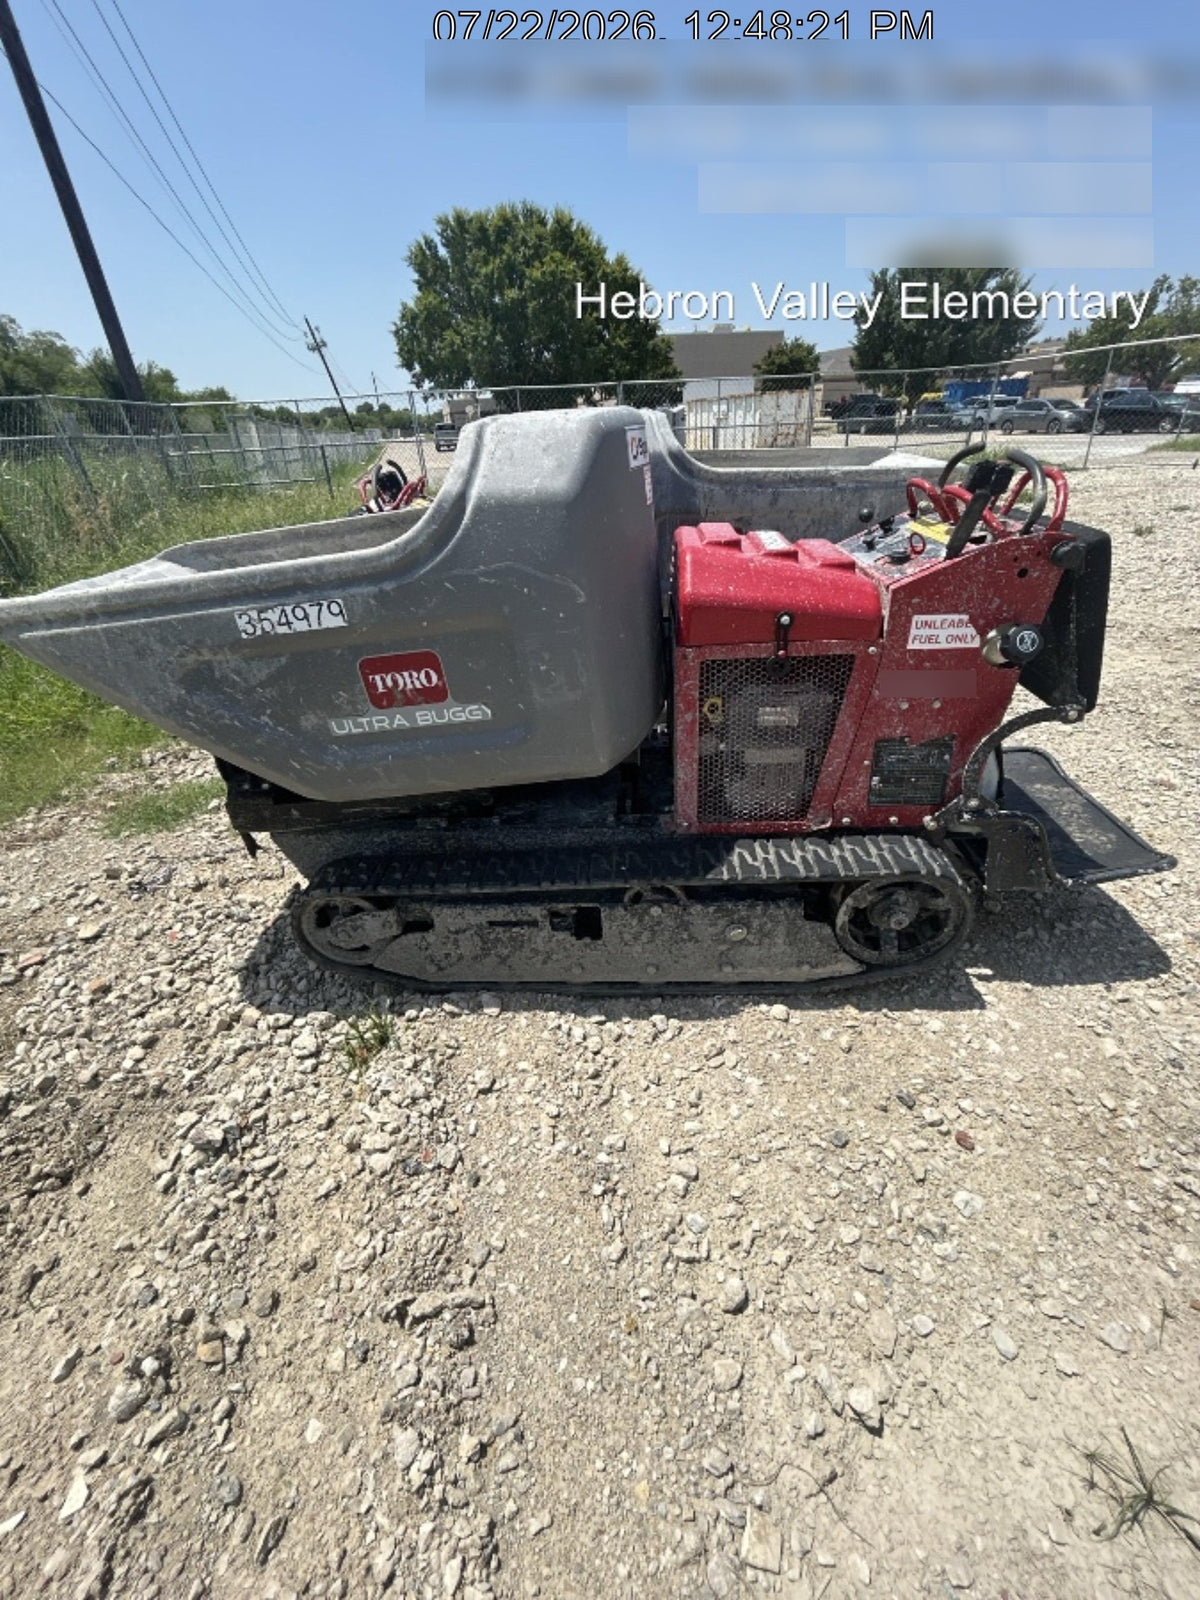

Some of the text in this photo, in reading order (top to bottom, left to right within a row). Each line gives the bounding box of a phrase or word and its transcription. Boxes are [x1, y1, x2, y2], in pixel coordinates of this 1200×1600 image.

[237, 600, 347, 637] 354979
[911, 633, 978, 645] FUEL ONLY
[369, 667, 439, 693] TORO
[331, 713, 410, 735] ULTRA
